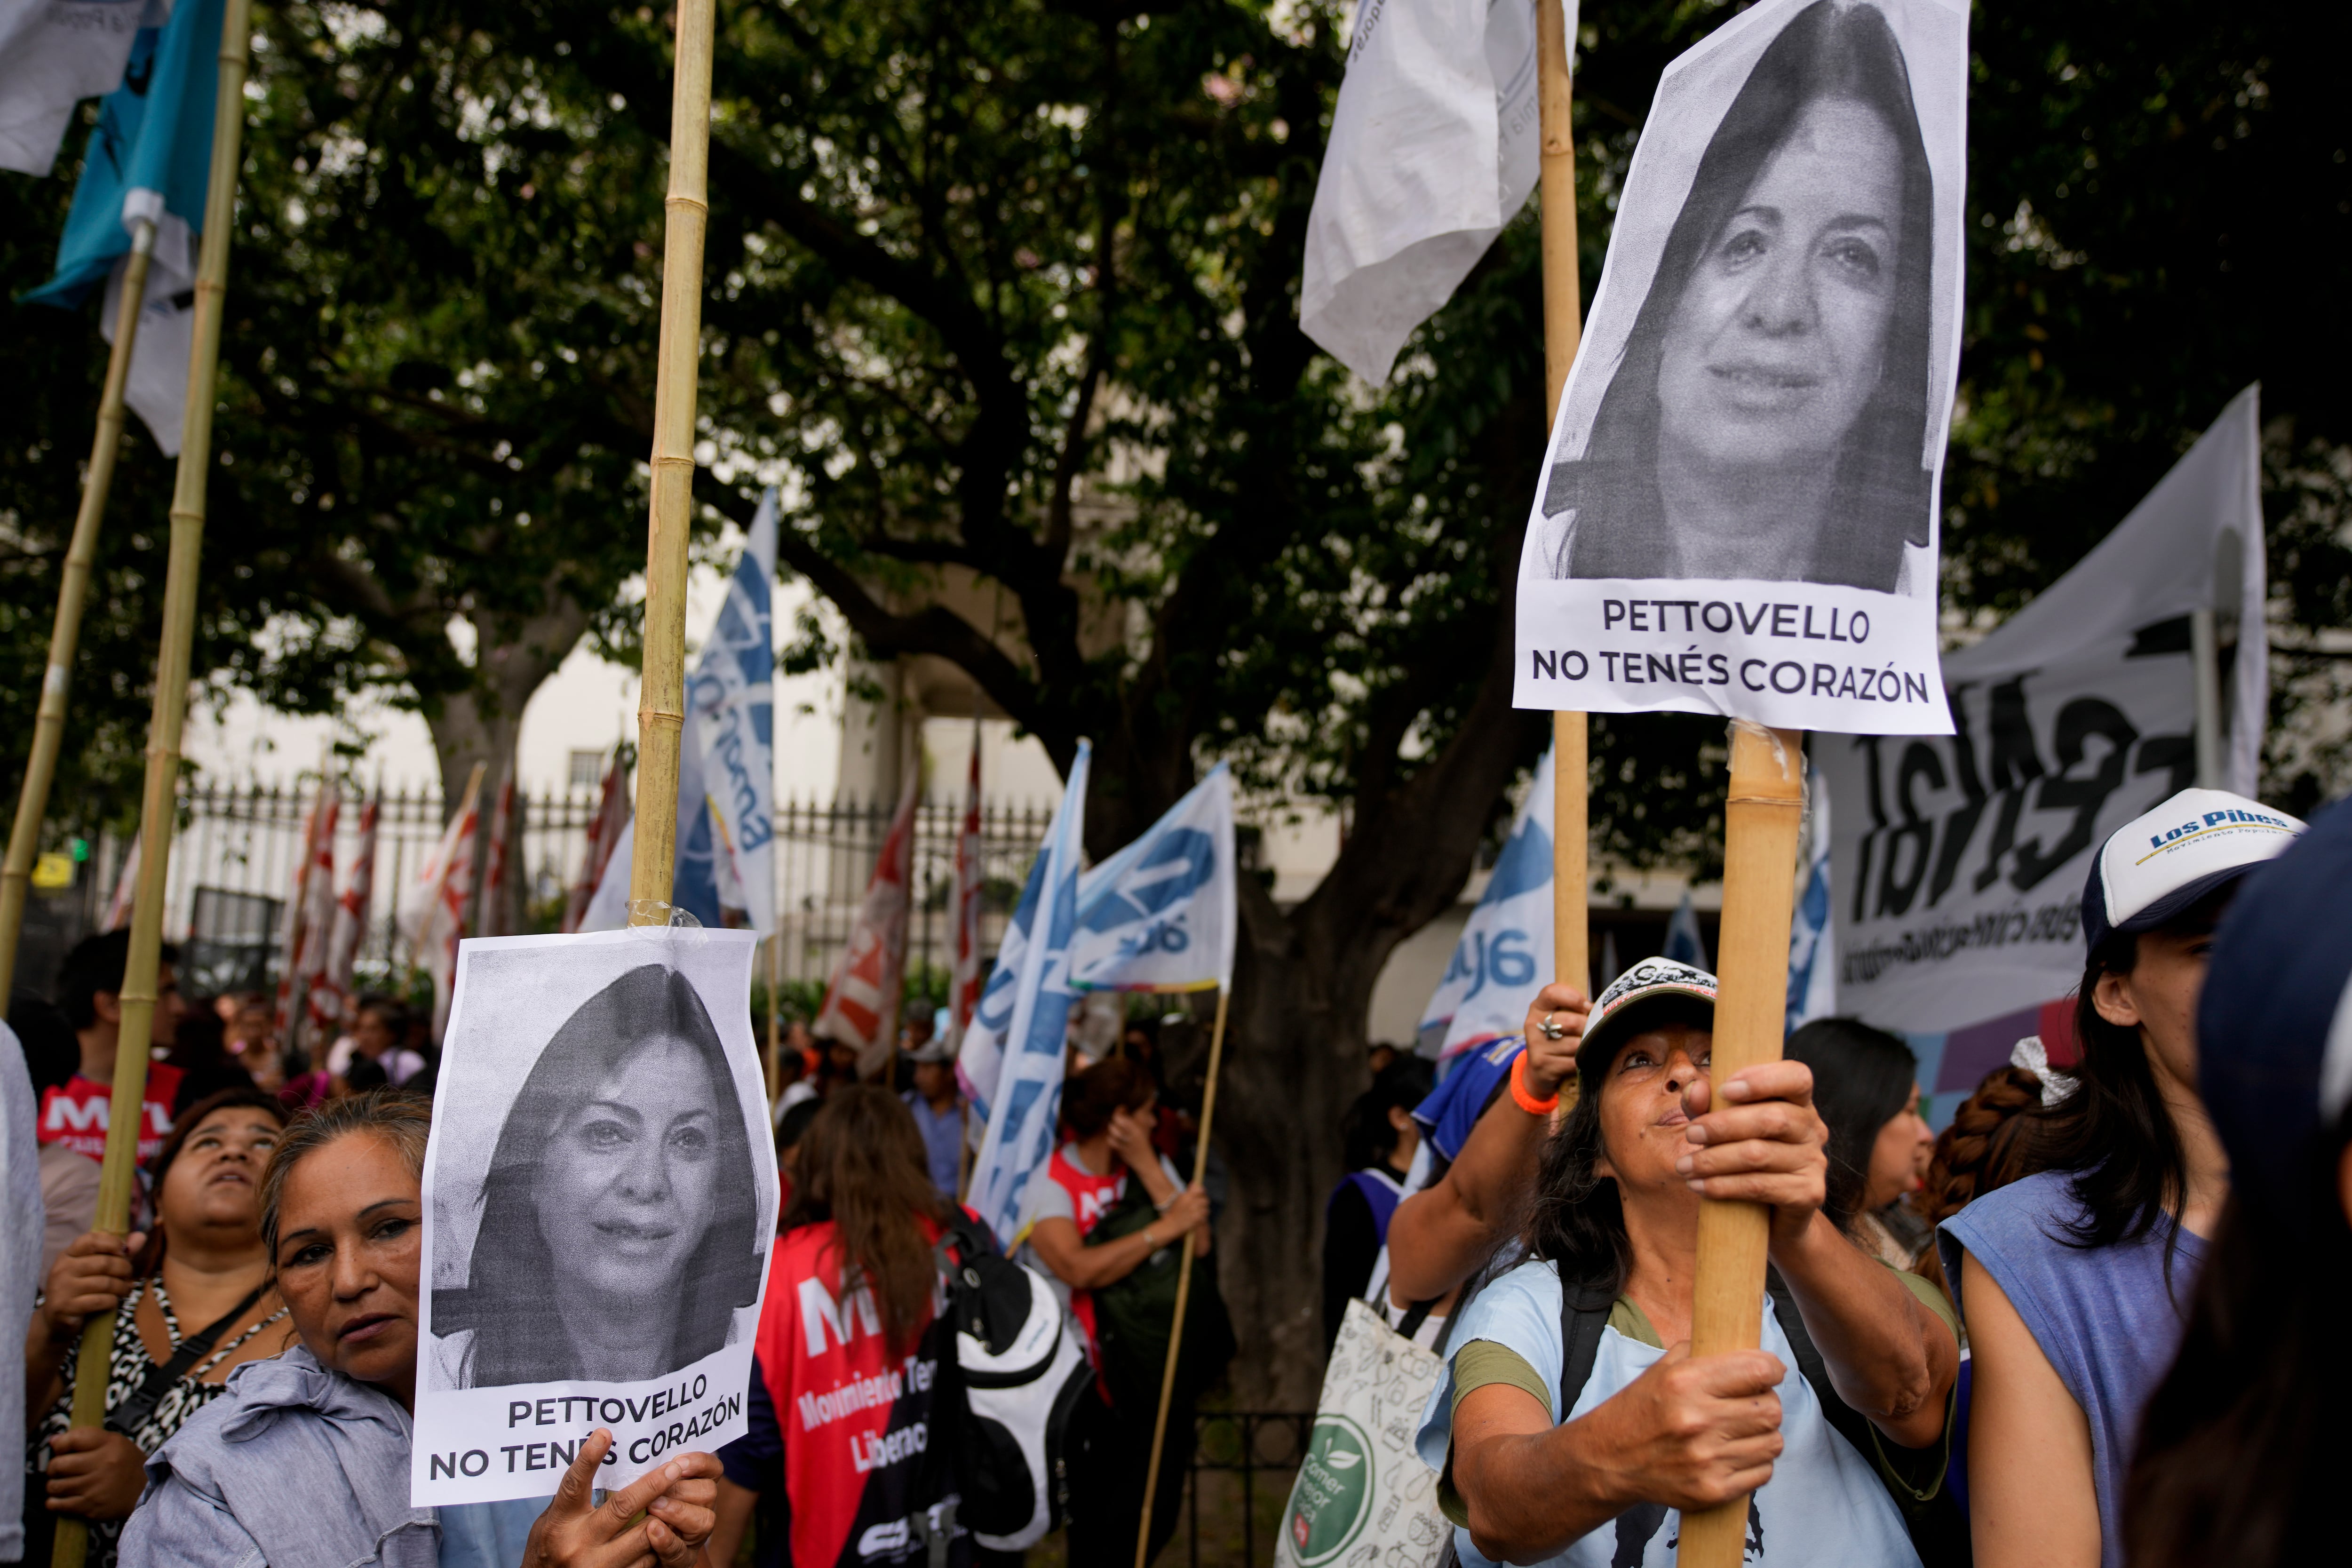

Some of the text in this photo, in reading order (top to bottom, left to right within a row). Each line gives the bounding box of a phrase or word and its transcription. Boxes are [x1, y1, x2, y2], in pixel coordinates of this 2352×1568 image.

[1603, 599, 1870, 644] PETTOVELLO
[1533, 645, 1930, 704] NO TENÉS CORAZÓN
[2150, 809, 2288, 849] Los Pibes
[2166, 830, 2234, 854] Movimiento
[508, 1374, 707, 1428] PETTOVELLO
[430, 1392, 740, 1480] NO TENS CORAZÓN
